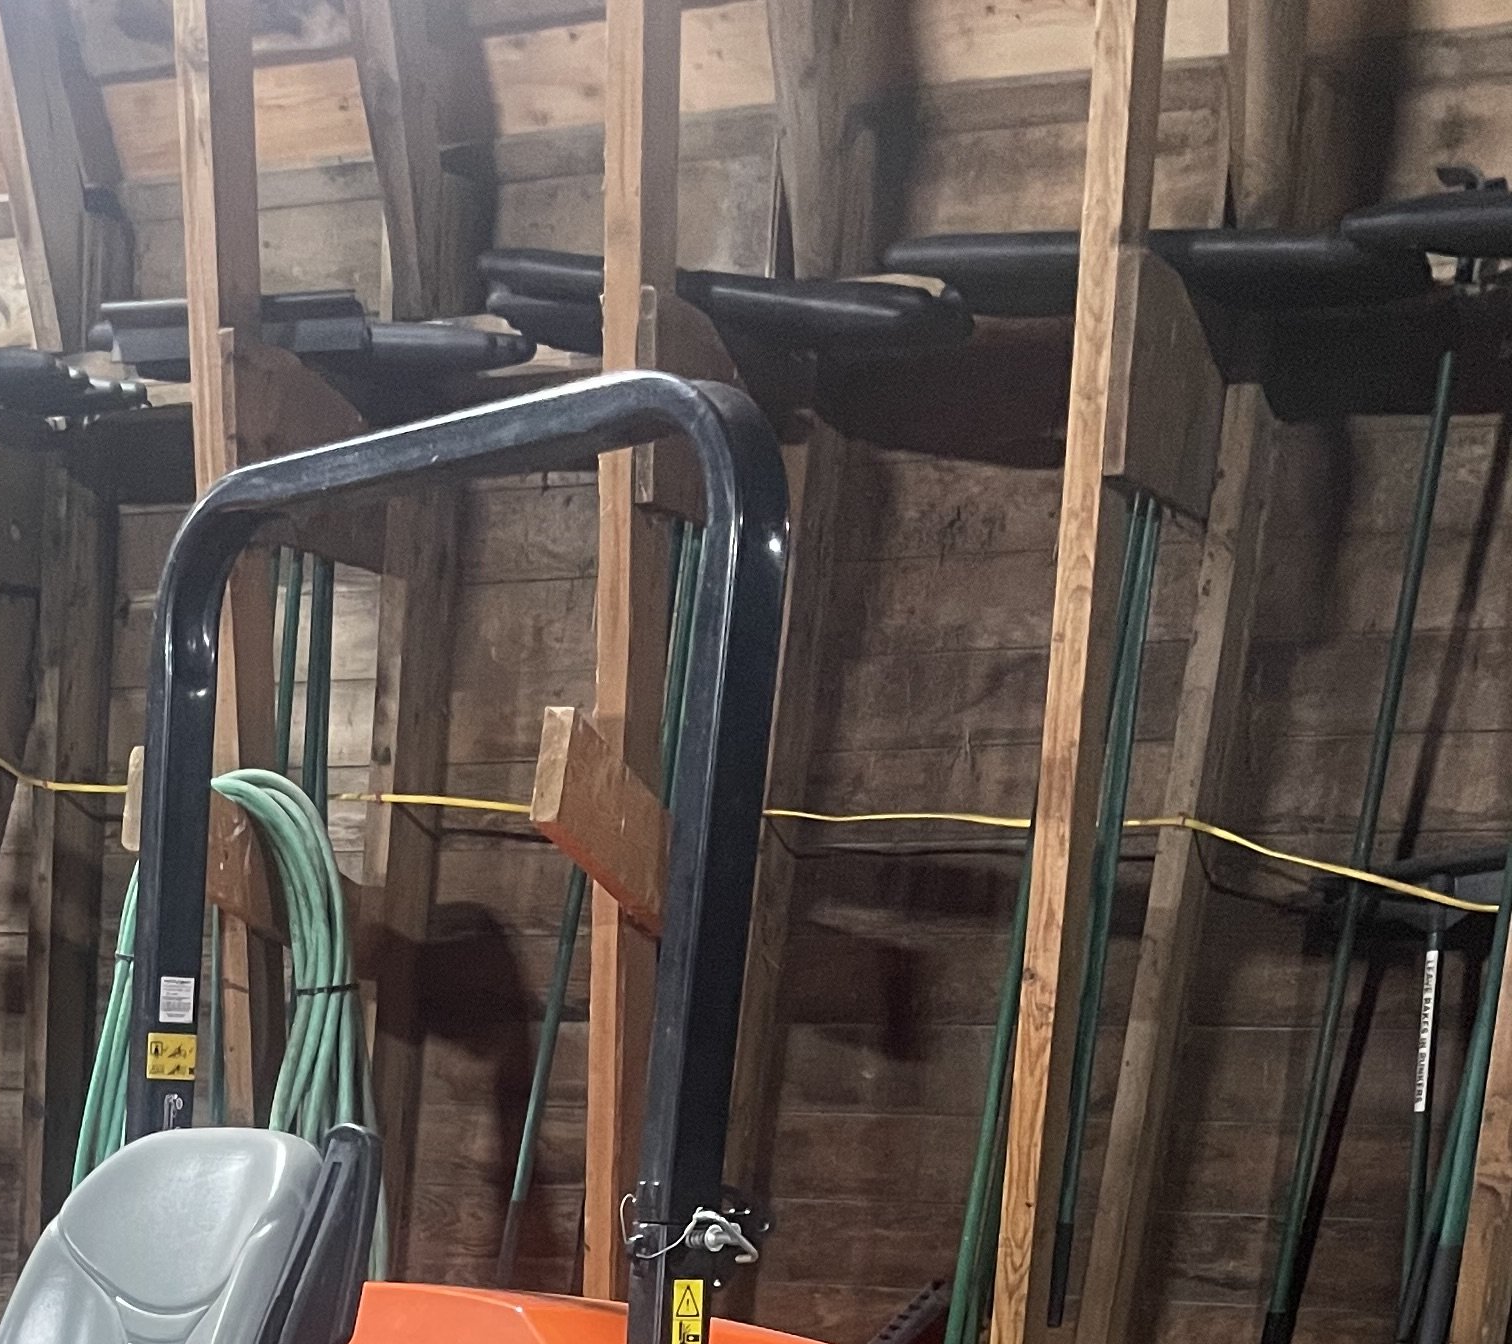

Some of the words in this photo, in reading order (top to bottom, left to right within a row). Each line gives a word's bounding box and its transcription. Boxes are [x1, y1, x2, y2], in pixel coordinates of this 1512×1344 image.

[1421, 997, 1432, 1034] RAKES
[1419, 1037, 1428, 1048] IN
[1415, 1052, 1427, 1103] BUNKERS
